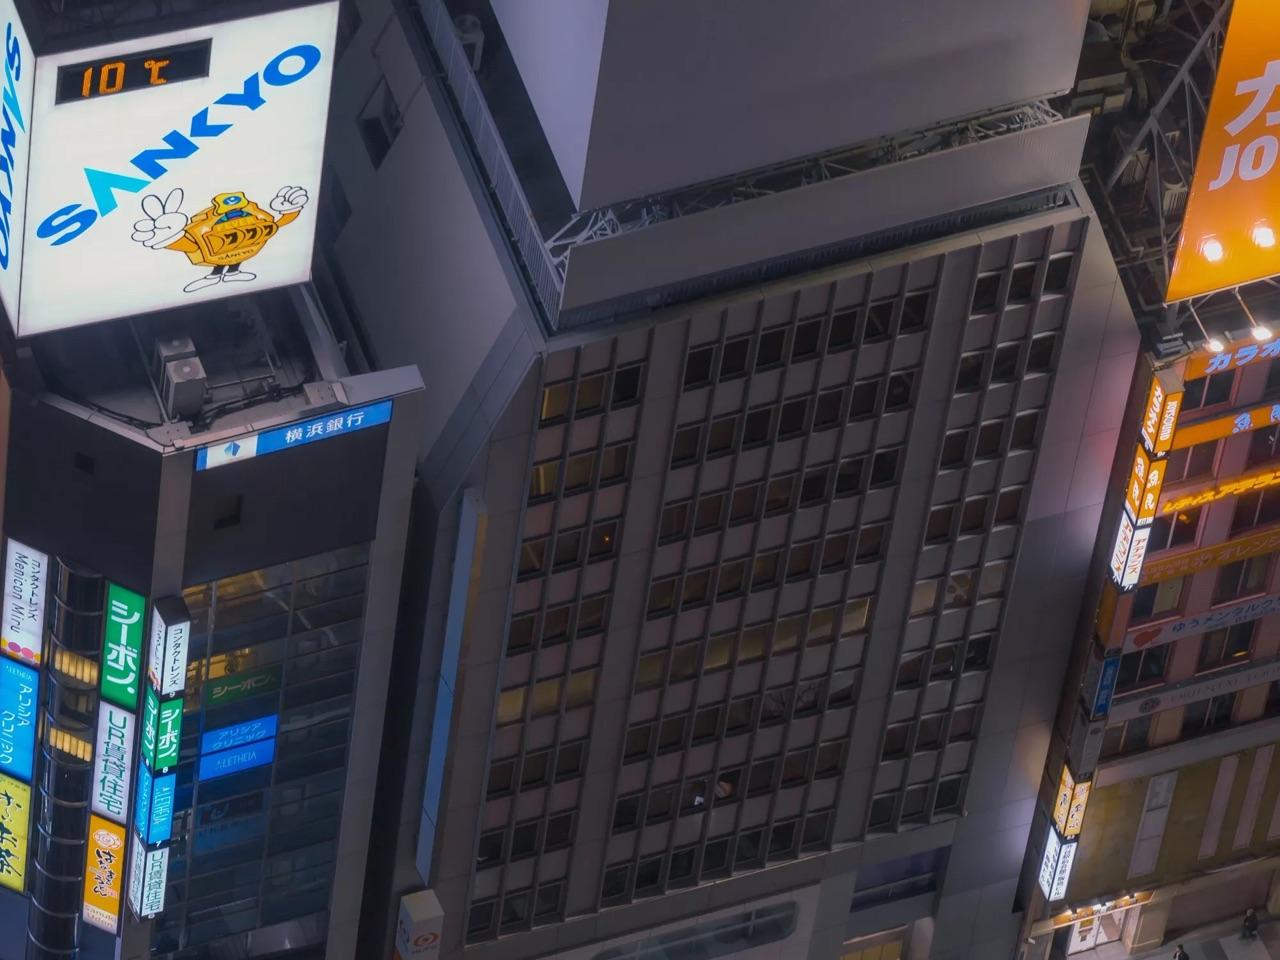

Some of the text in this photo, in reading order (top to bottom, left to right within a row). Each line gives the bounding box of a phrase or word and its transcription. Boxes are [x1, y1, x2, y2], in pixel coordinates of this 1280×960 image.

[82, 63, 125, 98] 10
[36, 44, 322, 246] SANKYO
[1208, 135, 1279, 192] JO
[285, 411, 365, 443] 横浜銀行
[10, 551, 29, 634] Menicon Miru
[98, 710, 128, 816] UR賃貸住宅
